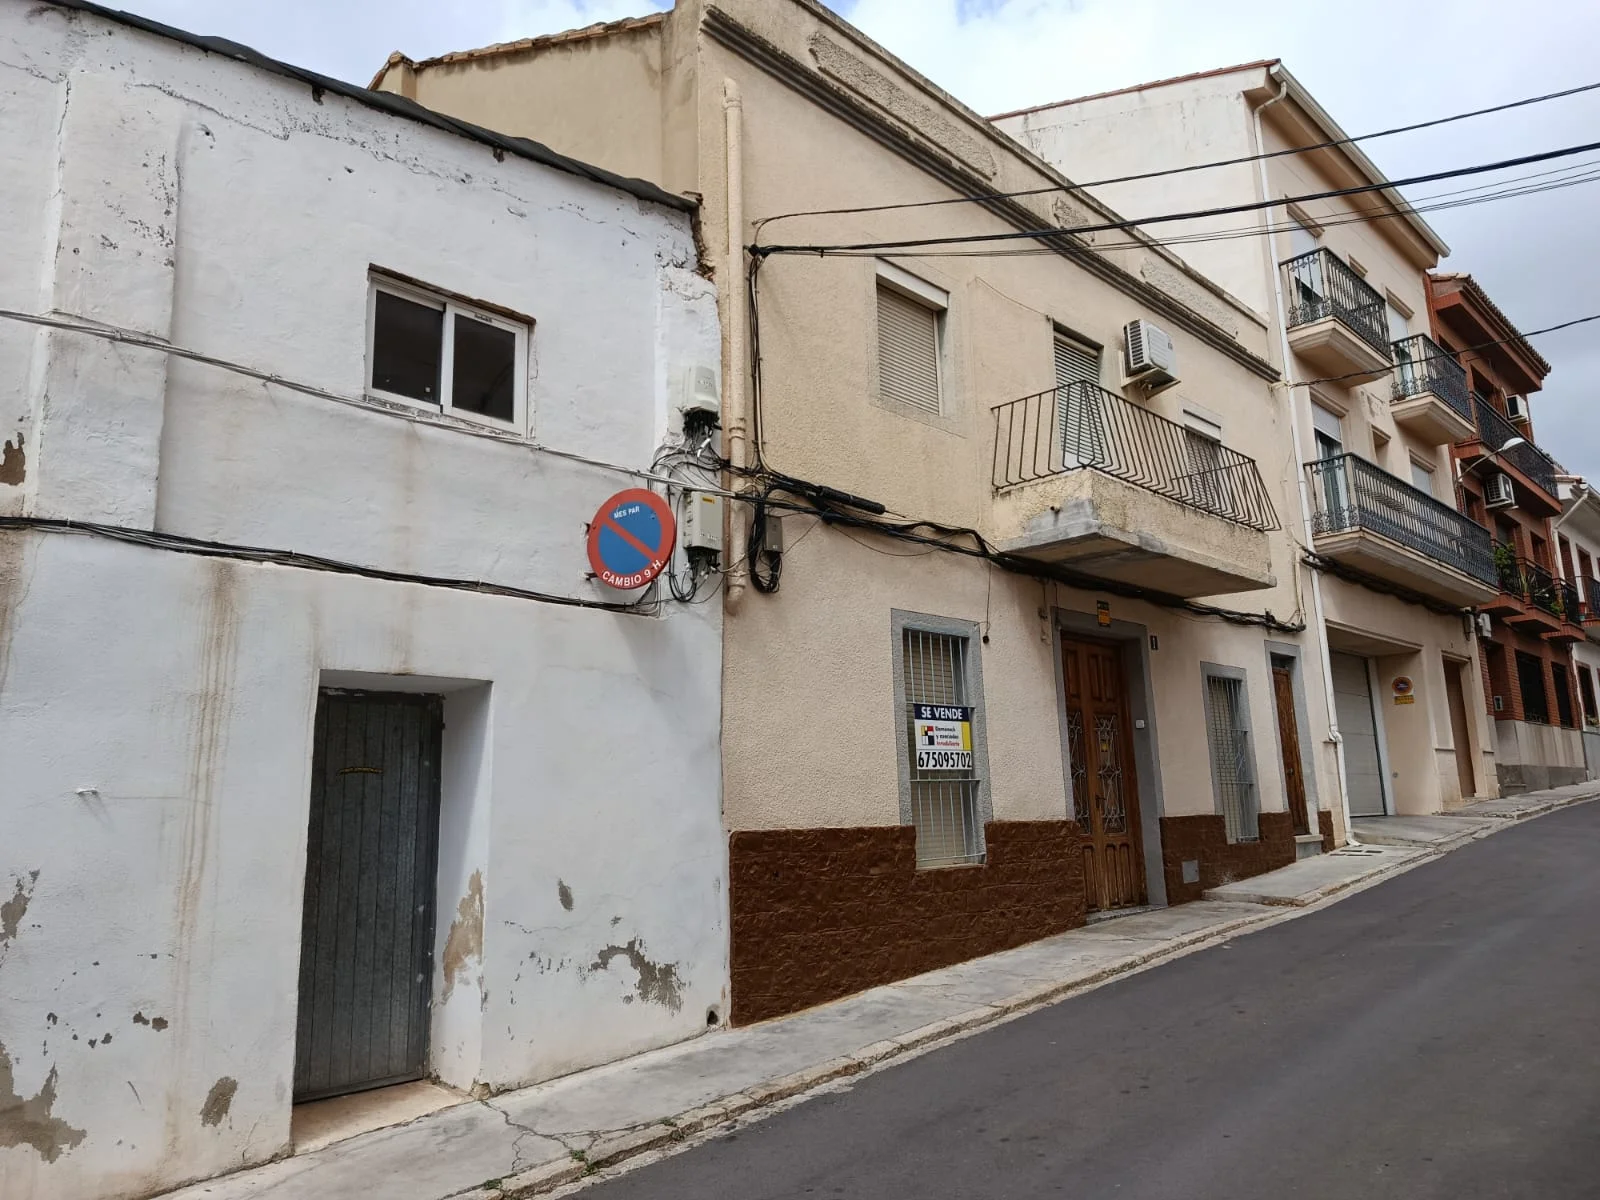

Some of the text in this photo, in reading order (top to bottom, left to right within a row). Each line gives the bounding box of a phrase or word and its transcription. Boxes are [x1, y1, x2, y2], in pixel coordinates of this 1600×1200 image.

[628, 506, 640, 515] PAR
[602, 571, 642, 586] CAMBIO
[644, 569, 651, 578] 9
[921, 706, 963, 720] SE VENDE
[918, 752, 972, 768] 675095702
